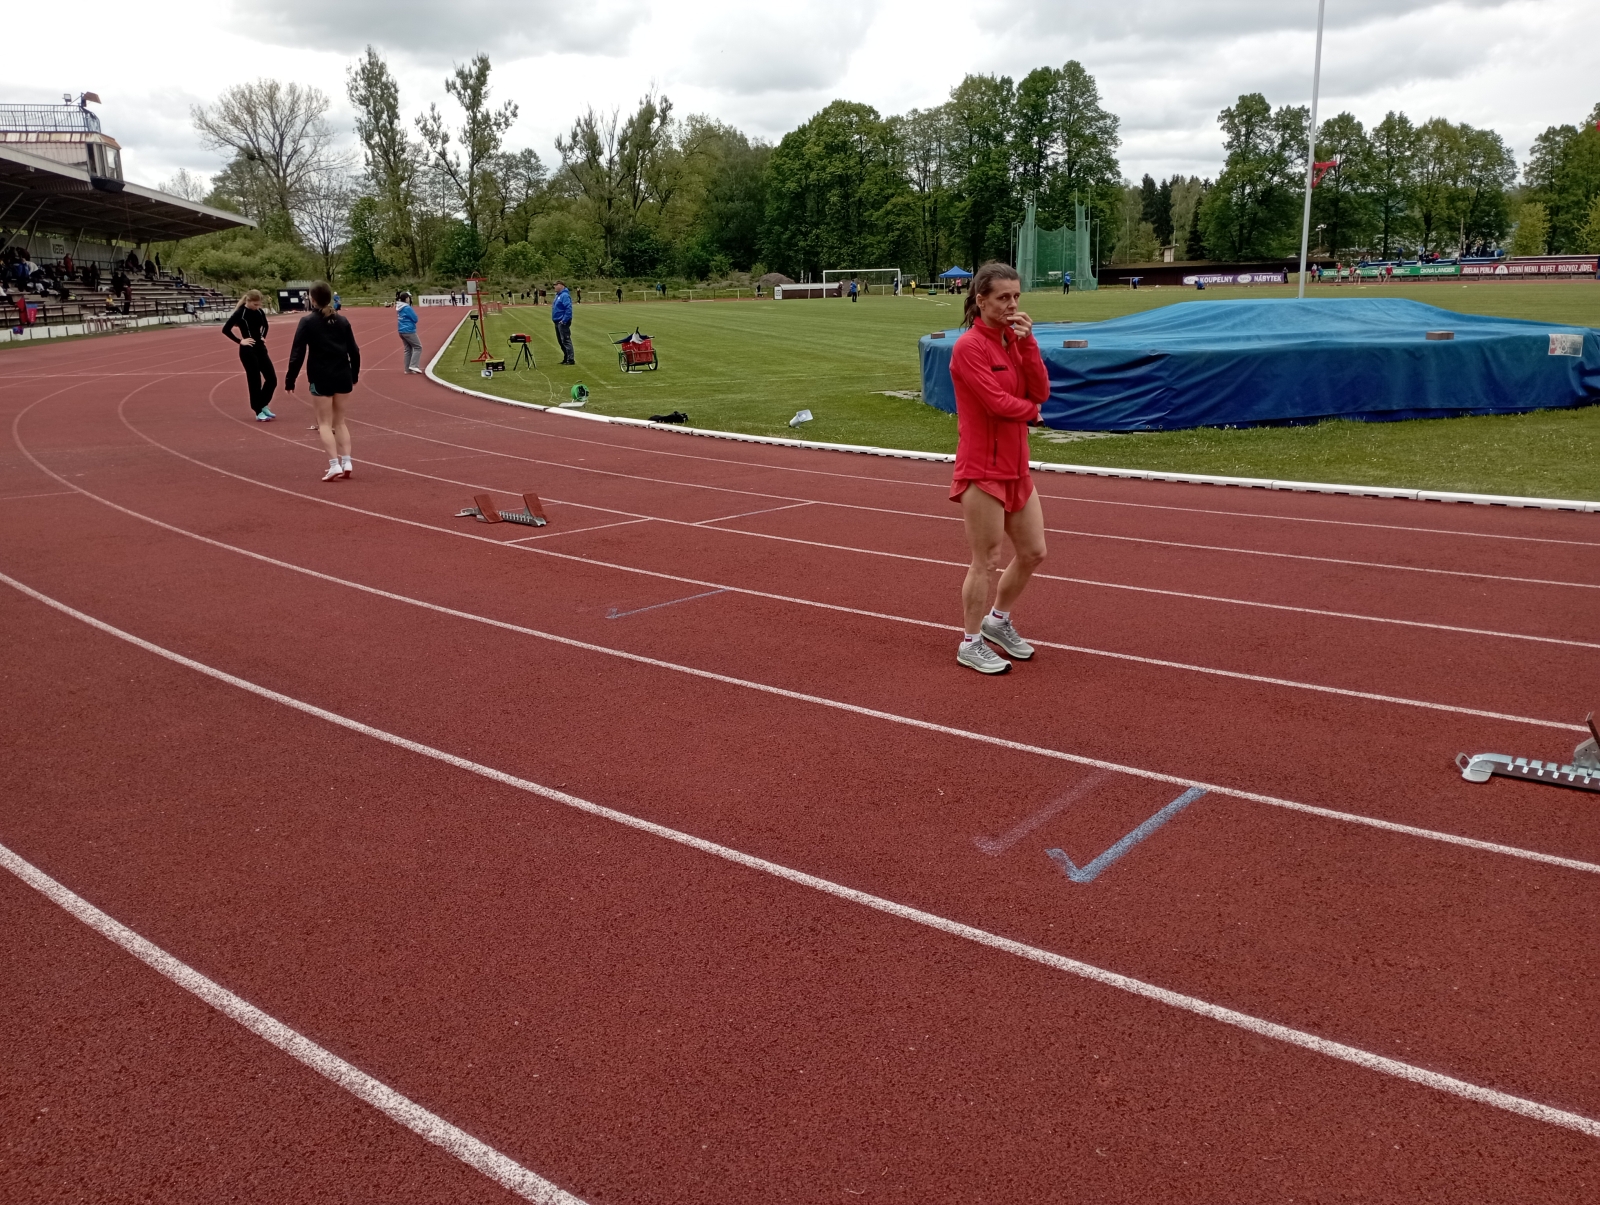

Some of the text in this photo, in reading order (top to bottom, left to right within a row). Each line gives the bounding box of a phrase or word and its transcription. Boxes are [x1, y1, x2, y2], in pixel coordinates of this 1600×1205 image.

[1480, 266, 1494, 274] PERLA
[1524, 265, 1539, 273] MENU
[1540, 265, 1556, 273] BUFET
[1558, 264, 1578, 272] ROZVOZ
